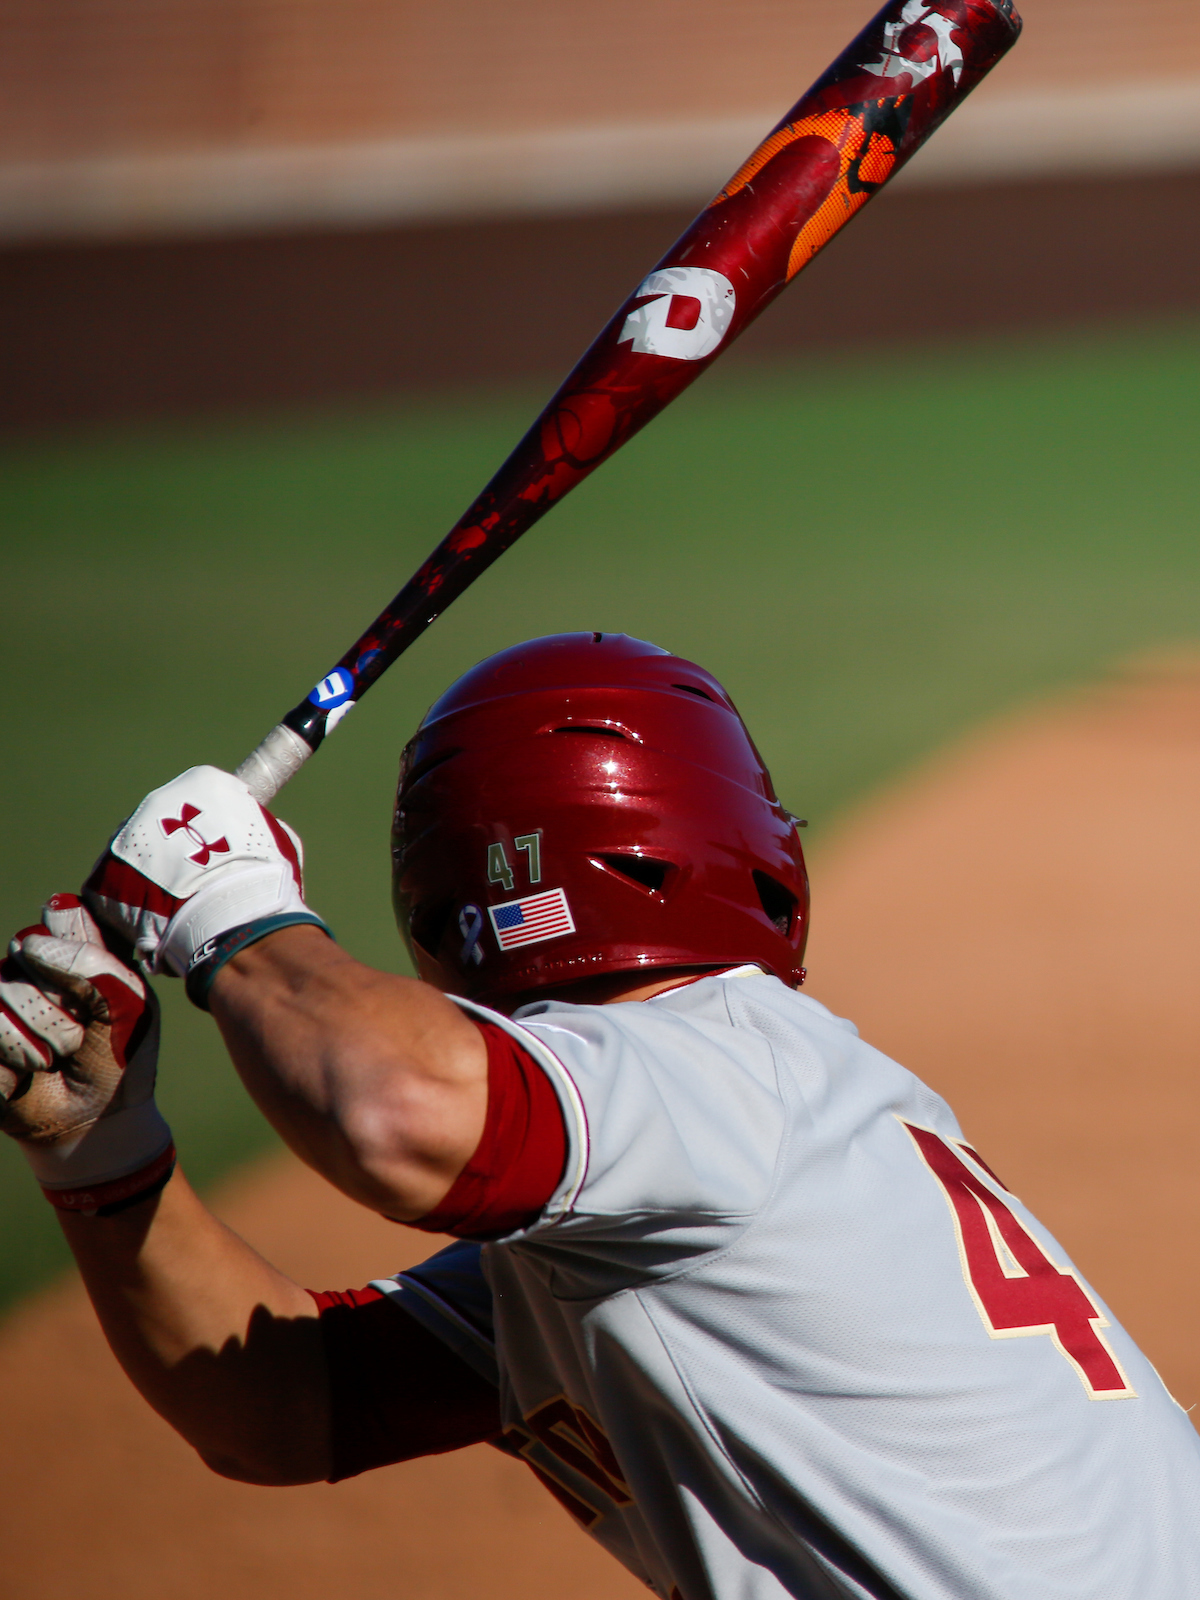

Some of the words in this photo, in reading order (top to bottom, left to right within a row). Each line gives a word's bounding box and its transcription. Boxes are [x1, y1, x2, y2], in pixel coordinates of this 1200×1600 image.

[487, 833, 541, 890] 47
[222, 928, 254, 953] 2021
[893, 1113, 1141, 1401] 4
